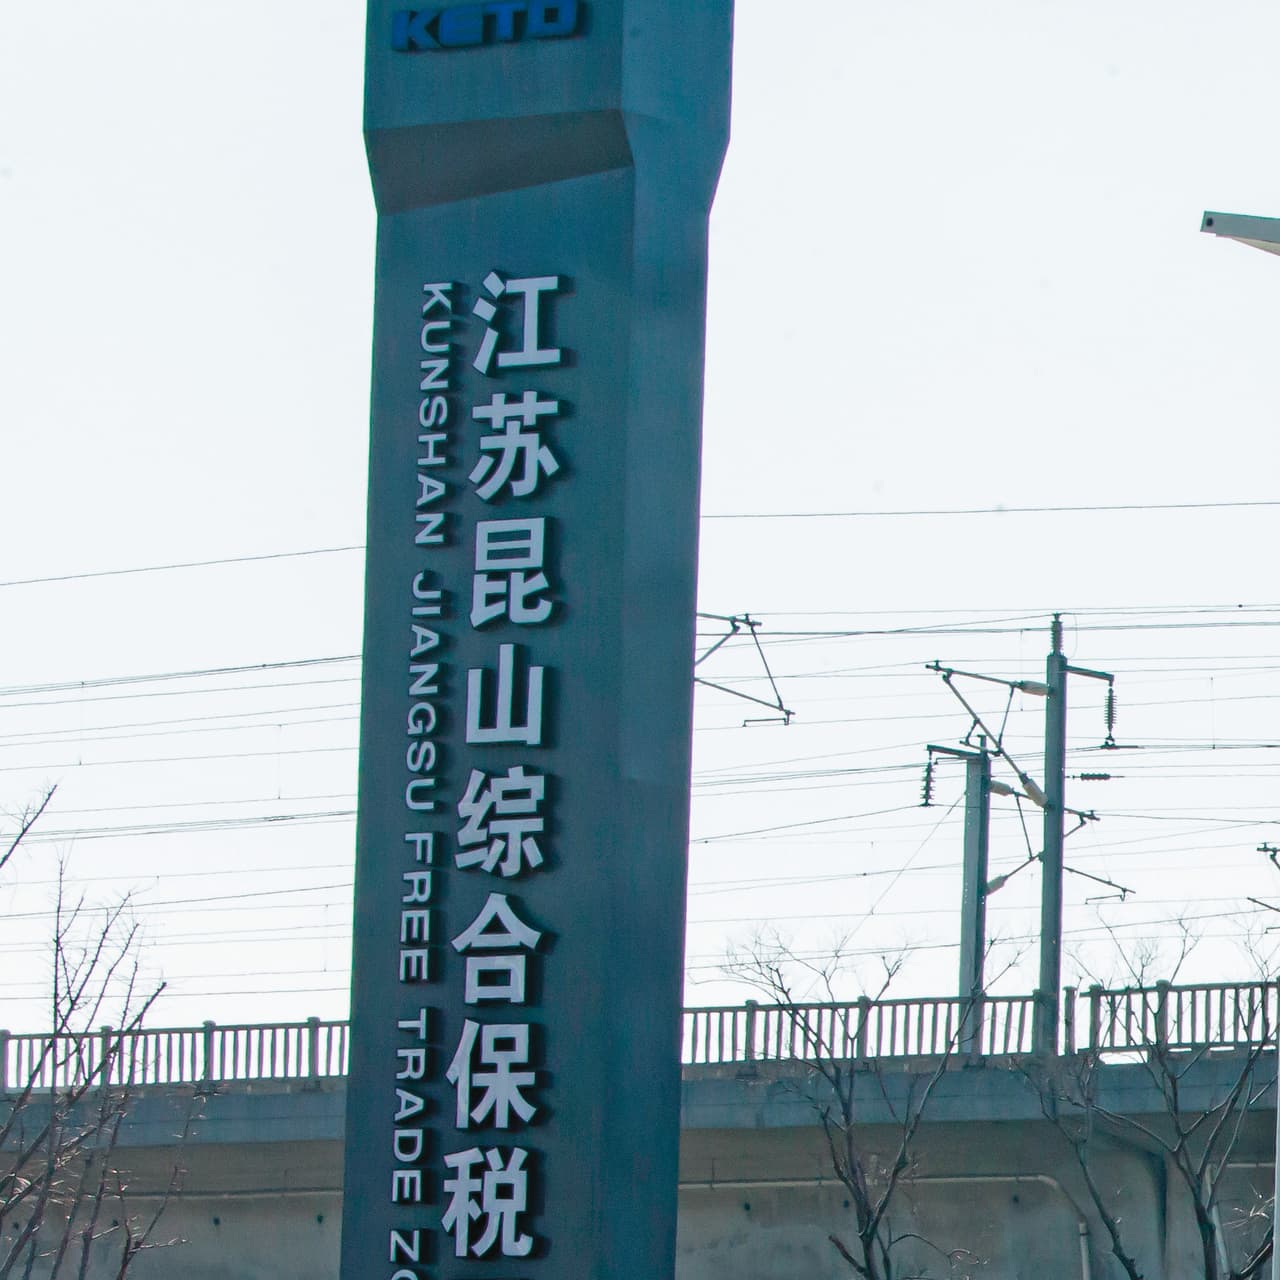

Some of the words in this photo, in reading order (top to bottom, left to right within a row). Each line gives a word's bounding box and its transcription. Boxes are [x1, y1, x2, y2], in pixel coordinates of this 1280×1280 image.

[415, 282, 452, 545] KUNSHAN
[405, 571, 441, 811] JIANGSU
[400, 832, 433, 982] FREE
[391, 1008, 427, 1203] TRADE
